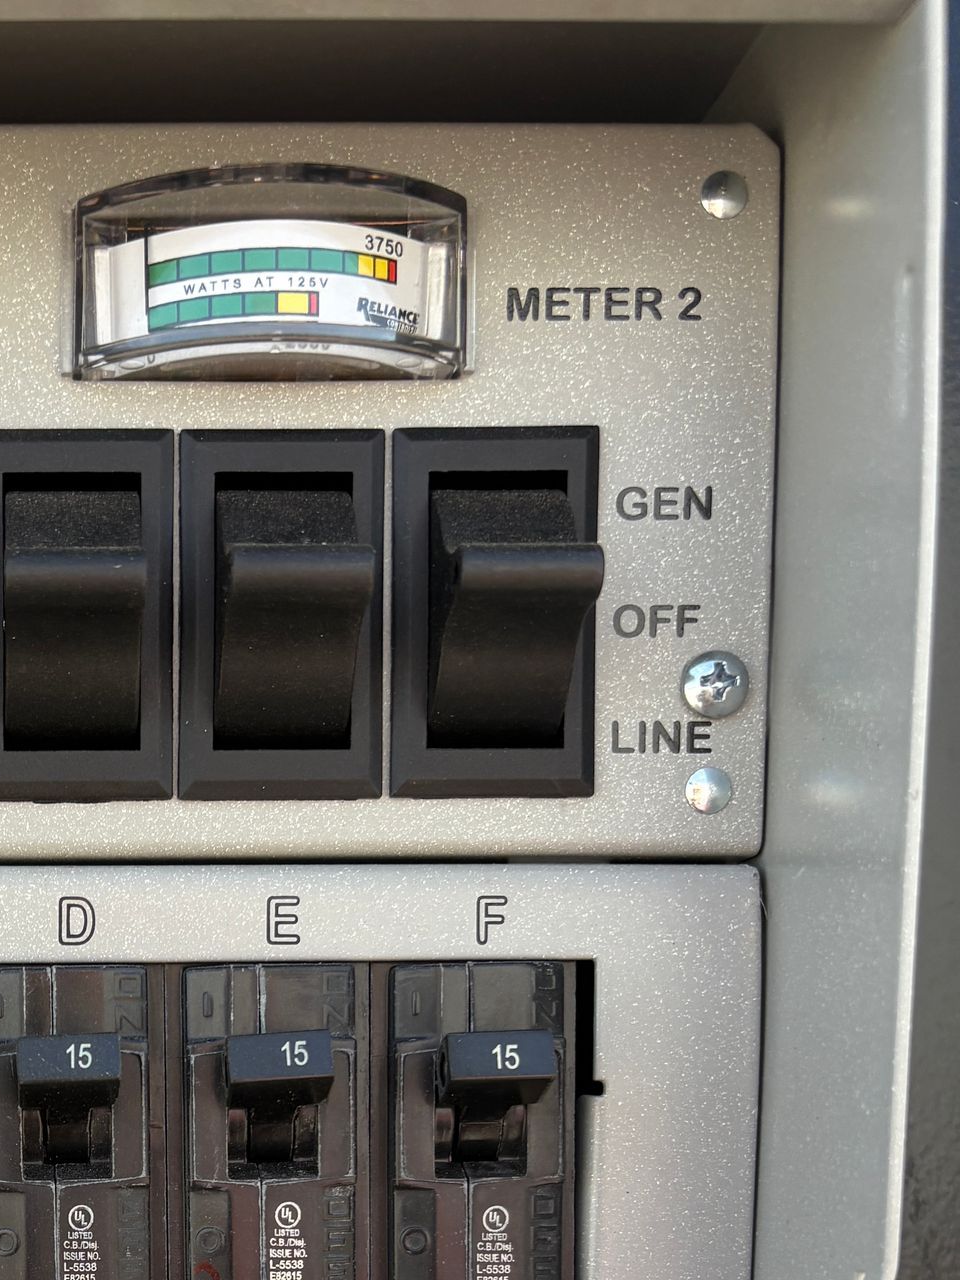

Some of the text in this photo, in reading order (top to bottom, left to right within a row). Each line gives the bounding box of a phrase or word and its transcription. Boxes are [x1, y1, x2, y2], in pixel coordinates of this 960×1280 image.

[366, 235, 403, 257] 3750
[184, 277, 328, 295] WATTS AT 125V
[507, 287, 701, 321] METER 2
[617, 486, 712, 520] GEN
[613, 604, 701, 638] OFF
[612, 721, 712, 754] LINE
[59, 897, 95, 945] D
[267, 896, 300, 945] E
[477, 896, 507, 945] F
[67, 1044, 91, 1068] 15
[281, 1041, 308, 1065] 15
[492, 1045, 519, 1069] 15
[64, 1262, 97, 1271] L-5538
[270, 1260, 303, 1269] L-5538
[270, 1271, 302, 1280] E82615
[477, 1265, 510, 1273] L-5538
